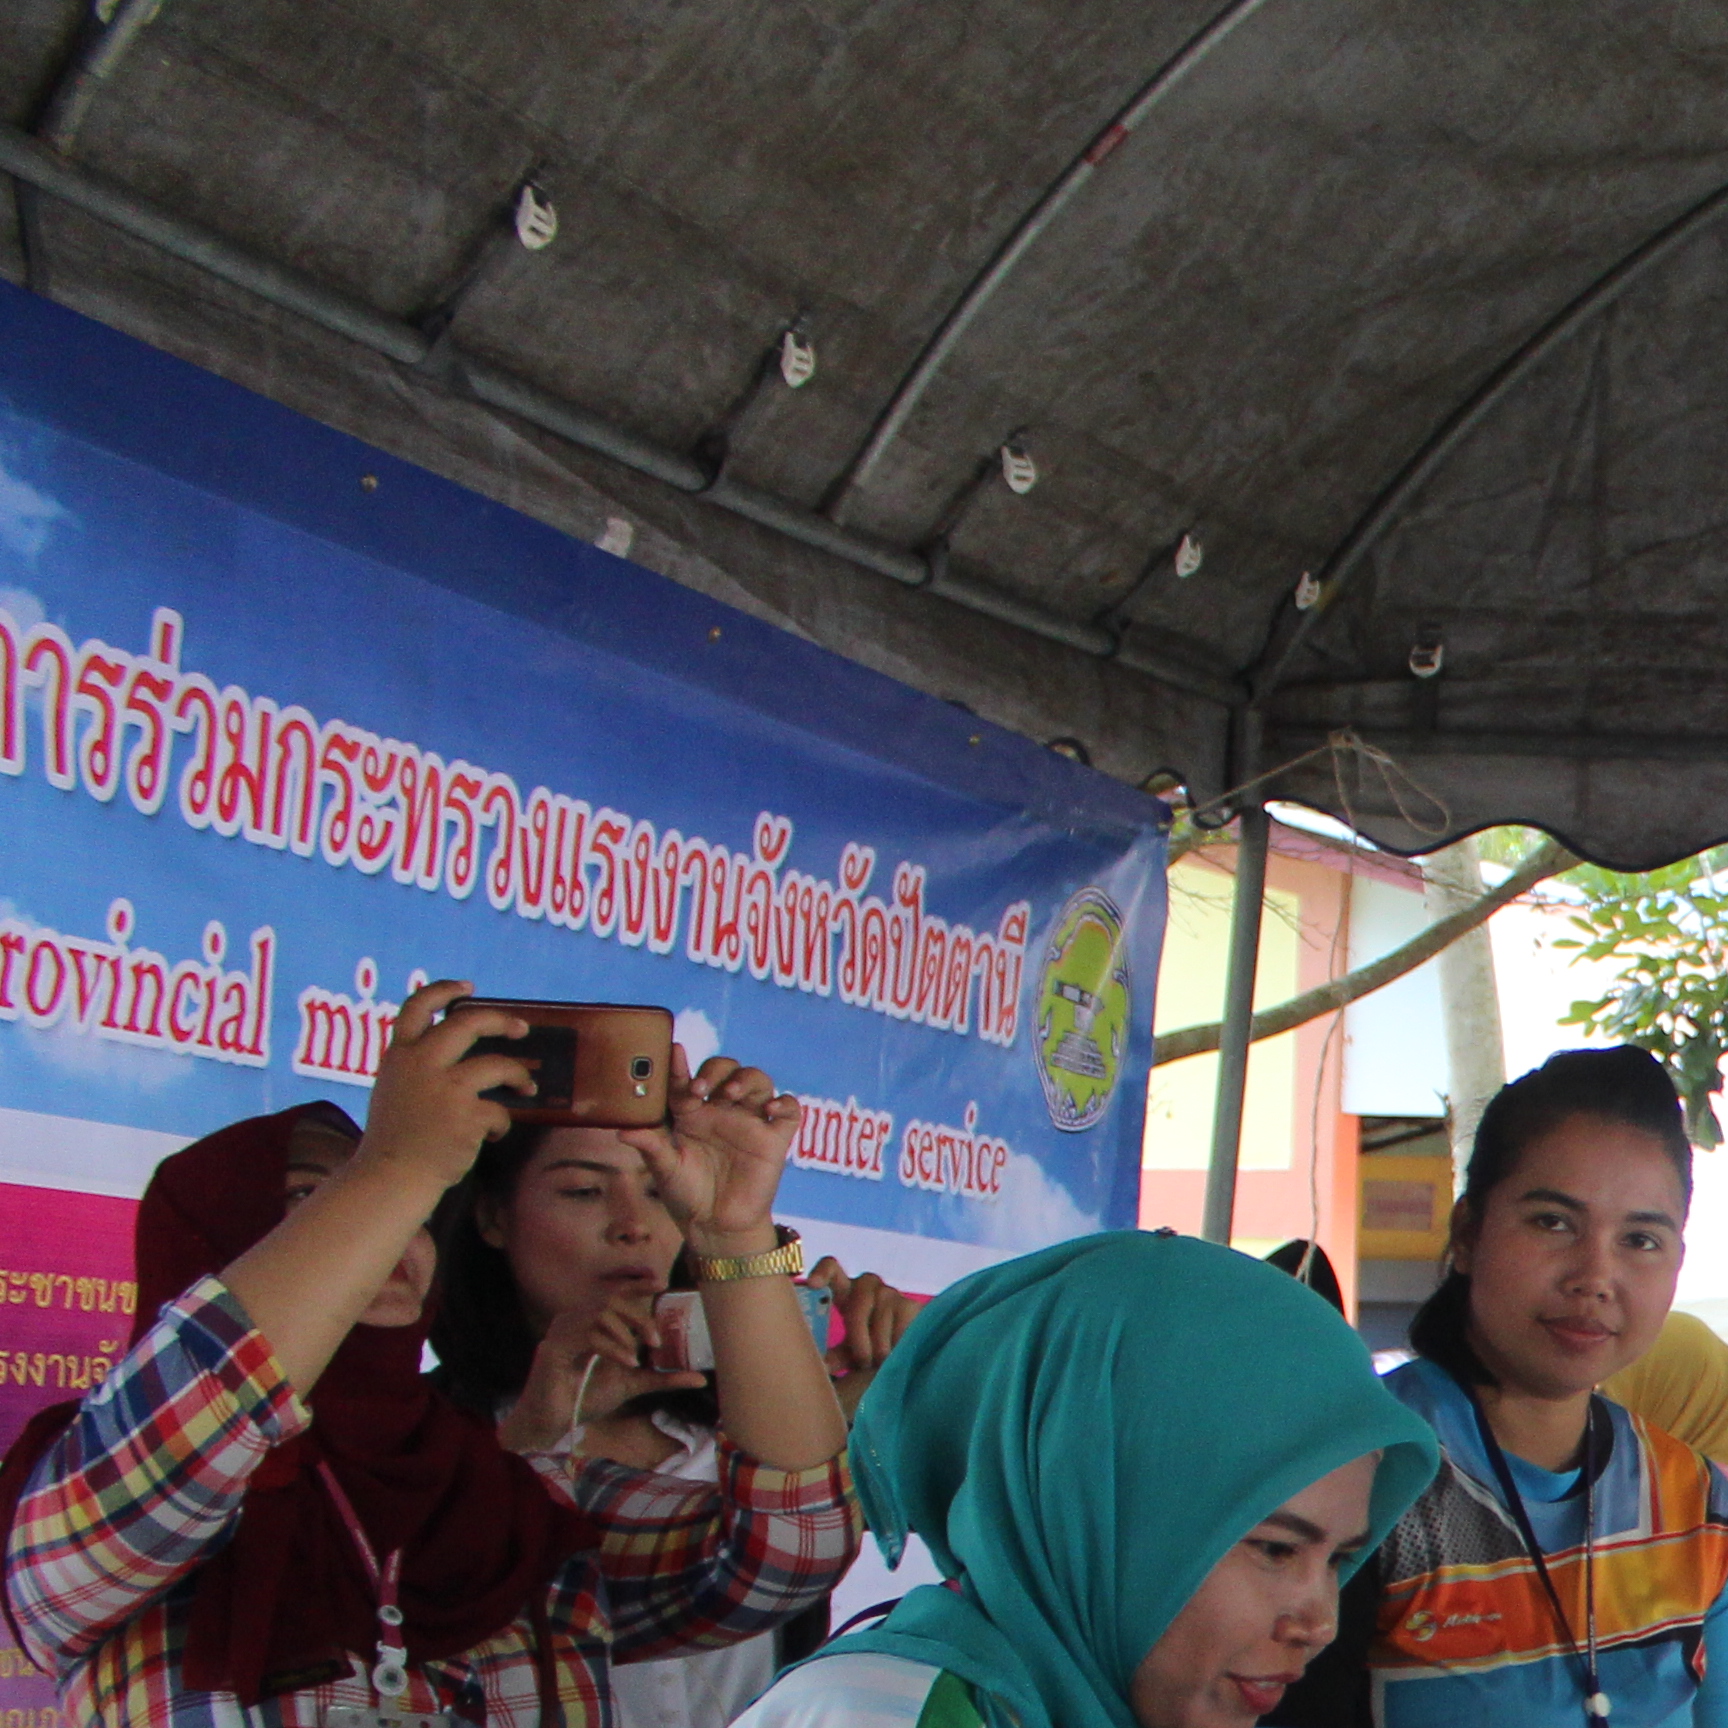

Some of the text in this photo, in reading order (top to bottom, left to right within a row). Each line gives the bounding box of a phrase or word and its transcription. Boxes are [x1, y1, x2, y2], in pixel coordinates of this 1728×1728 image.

[0, 908, 274, 1060] rovincial
[796, 1100, 889, 1174] unter
[902, 1105, 1008, 1194] service
